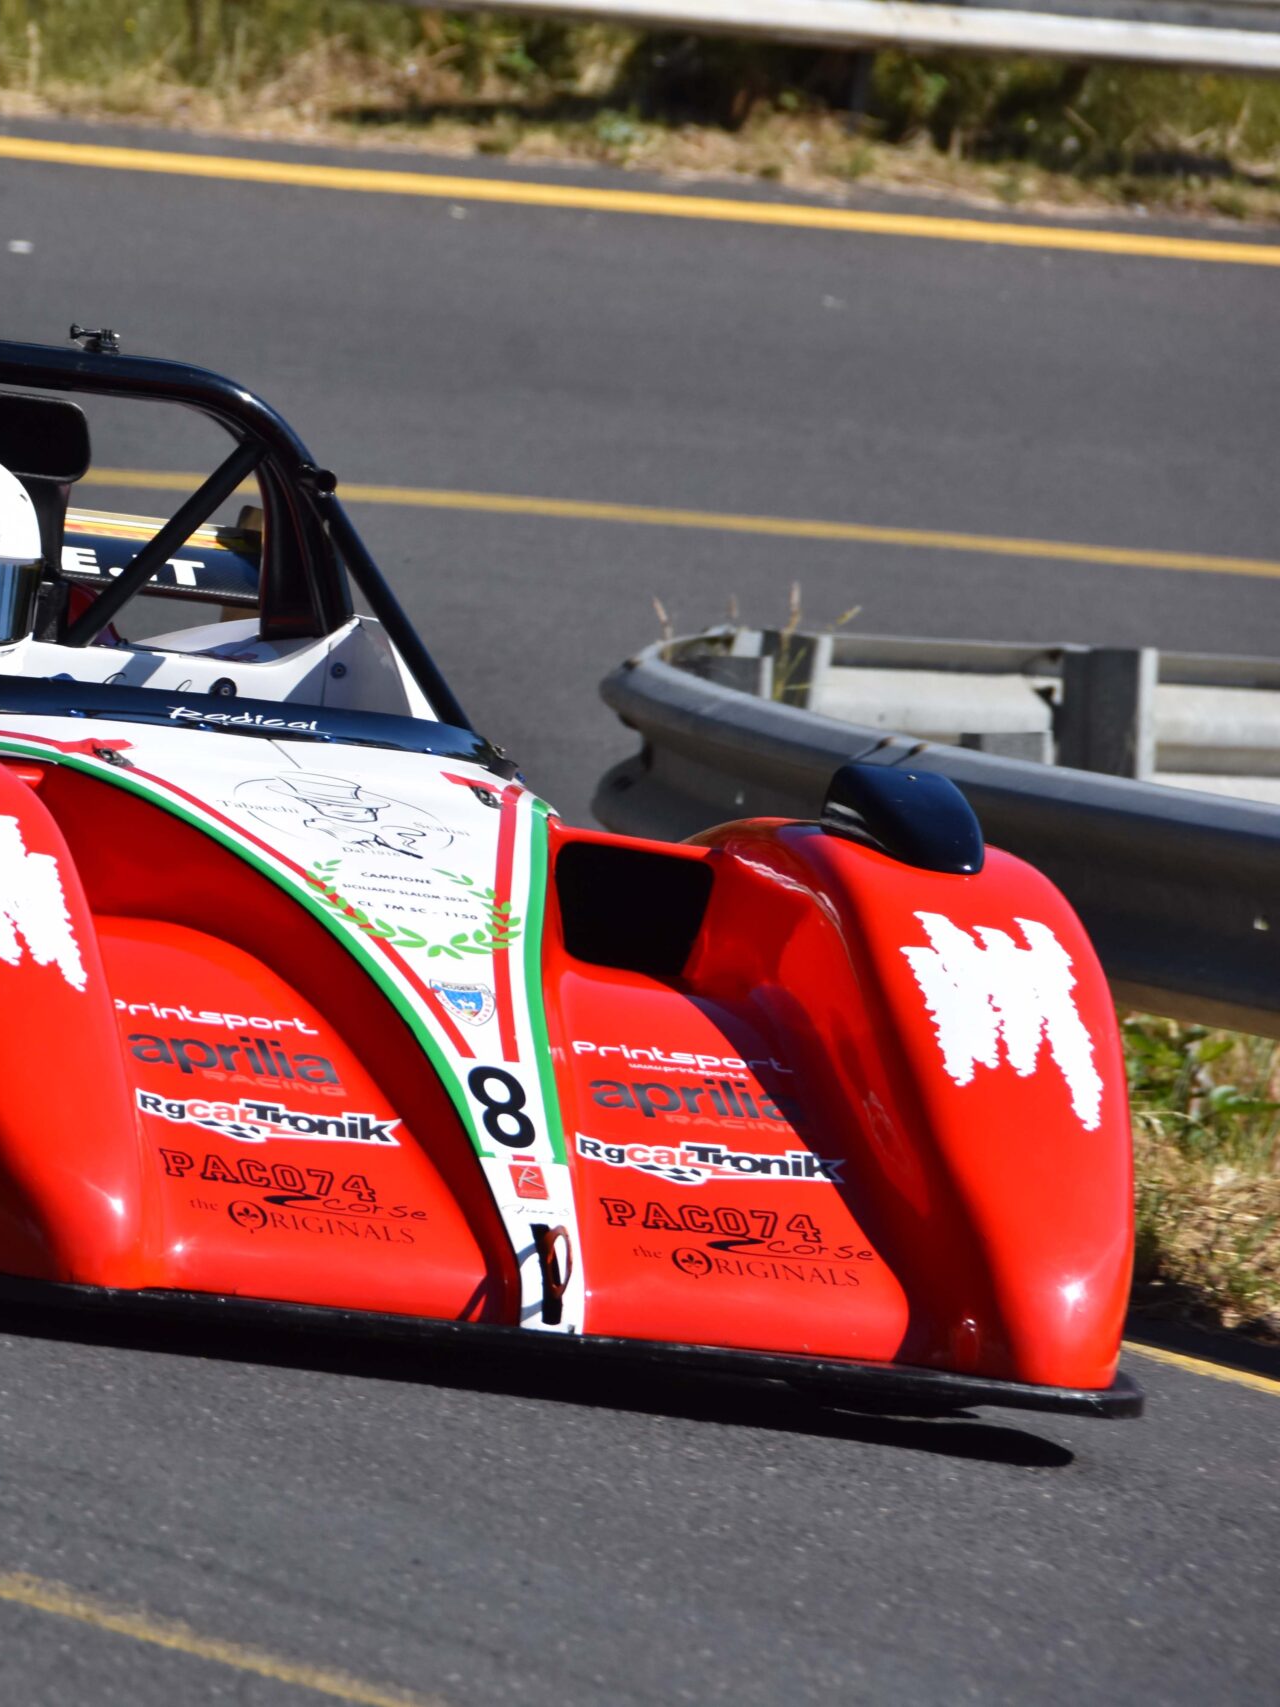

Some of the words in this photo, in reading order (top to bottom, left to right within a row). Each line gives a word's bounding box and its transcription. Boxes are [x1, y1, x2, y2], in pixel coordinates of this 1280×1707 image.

[61, 546, 206, 586] E.T
[166, 705, 320, 731] Radical
[360, 871, 433, 885] CAMPIONE
[127, 1032, 341, 1085] aprilia
[572, 1040, 794, 1074] Printsport
[200, 1070, 347, 1097] RACING
[588, 1077, 804, 1122] aprilia
[467, 1065, 536, 1149] 8
[665, 1114, 797, 1133] RACIN
[158, 1147, 377, 1203] PACO74
[189, 1197, 219, 1211] the
[599, 1197, 822, 1244] PACO74
[632, 1244, 663, 1259] the
